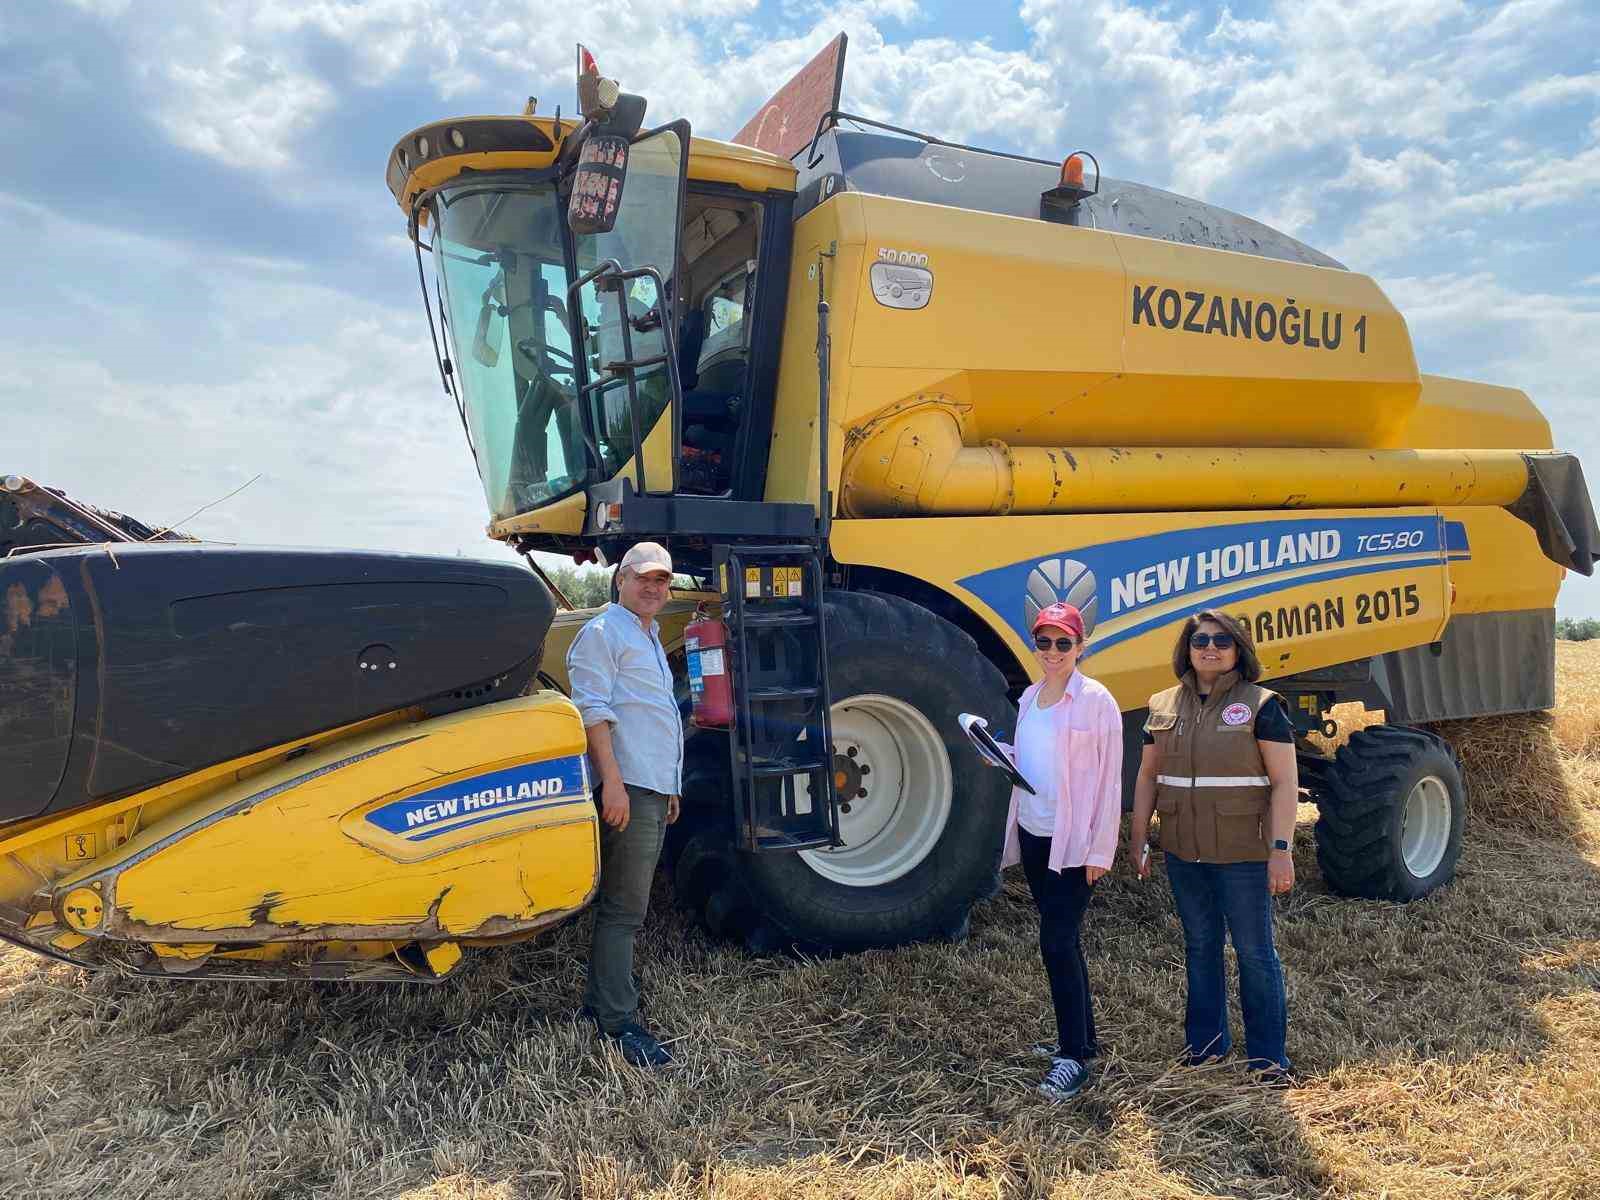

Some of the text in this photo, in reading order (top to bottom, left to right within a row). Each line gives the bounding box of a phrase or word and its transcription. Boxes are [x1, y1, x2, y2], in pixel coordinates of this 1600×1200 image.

[1132, 284, 1367, 354] KOZANOĞLU 1
[1110, 556, 1190, 614] NEW
[1197, 529, 1341, 585] HOLLAND
[1355, 584, 1420, 625] 2015
[405, 776, 563, 827] NEW HOLLAND
